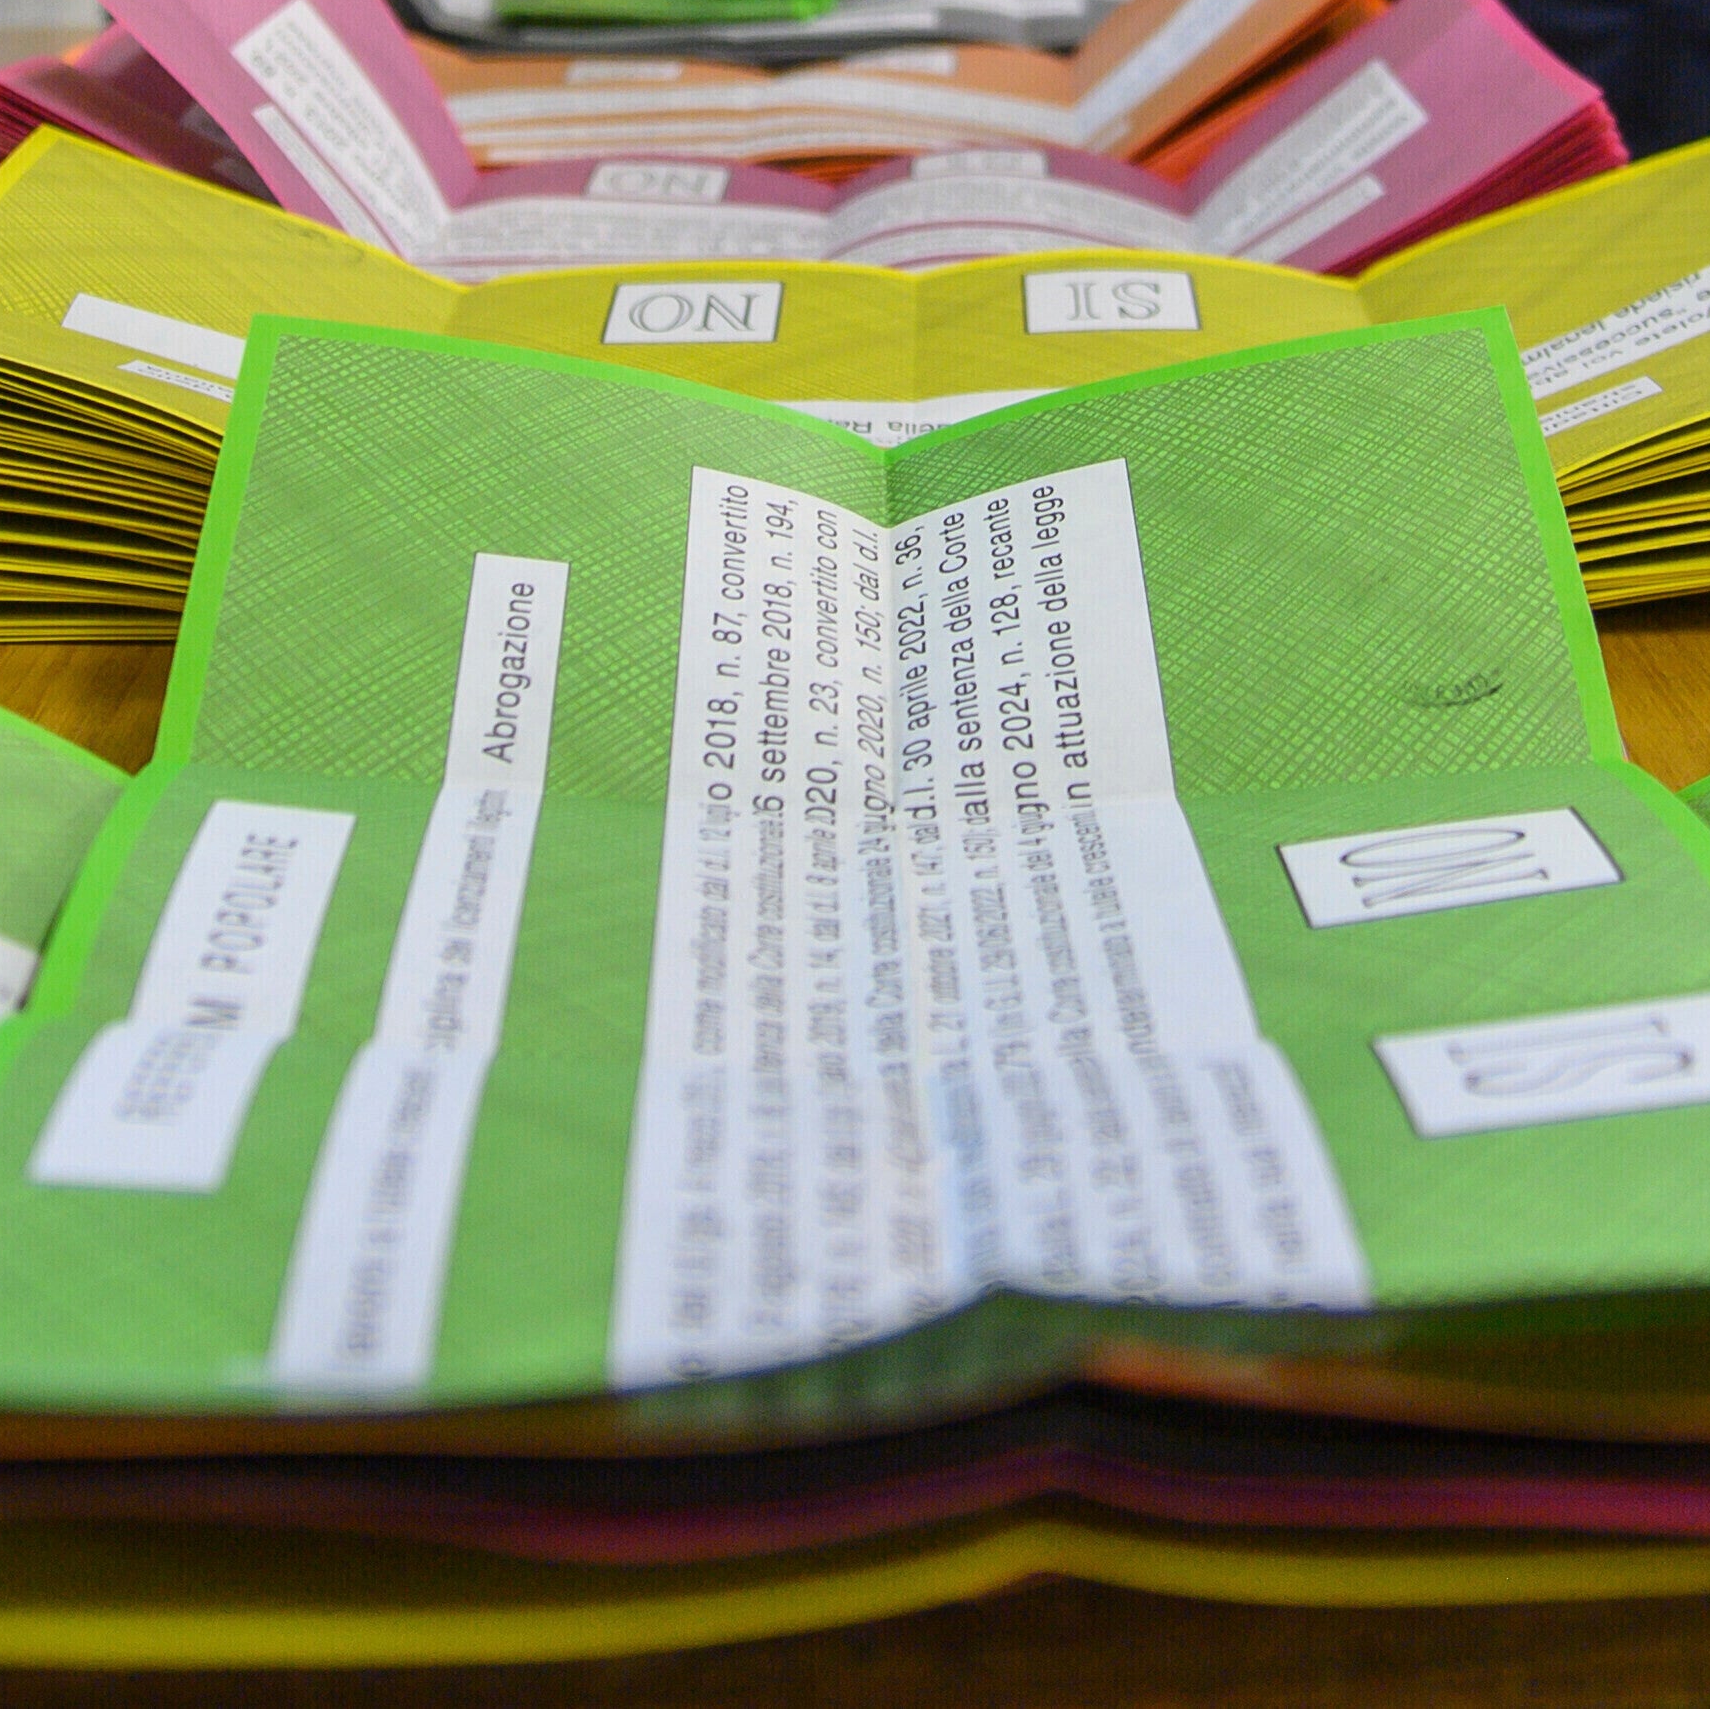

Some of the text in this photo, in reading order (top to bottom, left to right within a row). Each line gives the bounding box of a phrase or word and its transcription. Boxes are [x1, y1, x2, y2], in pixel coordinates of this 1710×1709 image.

[626, 289, 761, 336] NO
[1065, 280, 1166, 323] SI
[1535, 369, 1568, 385] ab
[1582, 349, 1624, 369] voi
[766, 501, 794, 538] 194,
[817, 510, 837, 549] con
[984, 499, 1014, 579] recante
[1032, 486, 1065, 549] legge
[720, 486, 748, 600] convertito
[771, 552, 792, 570] n.
[853, 530, 878, 561] d.l.
[893, 525, 922, 565] 36,
[939, 513, 967, 573] Corte
[855, 565, 879, 601] dal
[902, 567, 922, 590] n.
[1035, 553, 1068, 611] della
[712, 612, 743, 644] 87,
[762, 581, 792, 640] 2018,
[811, 557, 838, 667] convertito
[855, 606, 881, 651] 150;
[897, 594, 926, 660] 2022,
[942, 577, 972, 632] della
[989, 586, 1020, 636] 128,
[482, 583, 534, 764] Abrogazione
[717, 657, 740, 677] n.
[862, 666, 881, 684] n.
[1001, 642, 1023, 665] n.
[758, 649, 790, 782] settembre
[809, 681, 838, 715] 23,
[900, 665, 936, 730] aprile
[951, 637, 982, 751] sentenza
[998, 674, 1033, 750] 2024,
[1046, 621, 1088, 768] attuazione
[703, 692, 740, 769] 2018,
[815, 726, 837, 746] n.
[857, 695, 885, 759] 2020,
[903, 739, 932, 771] 30
[864, 764, 896, 833] giugno
[904, 778, 937, 818] d.l.
[955, 761, 990, 823] dalla
[1013, 762, 1054, 833] giugno
[1064, 781, 1093, 811] in
[858, 837, 890, 854] 24
[914, 824, 940, 844] dal
[1338, 824, 1551, 910] NO
[197, 833, 298, 973] POPOLARE
[1445, 1012, 1695, 1098] SI
